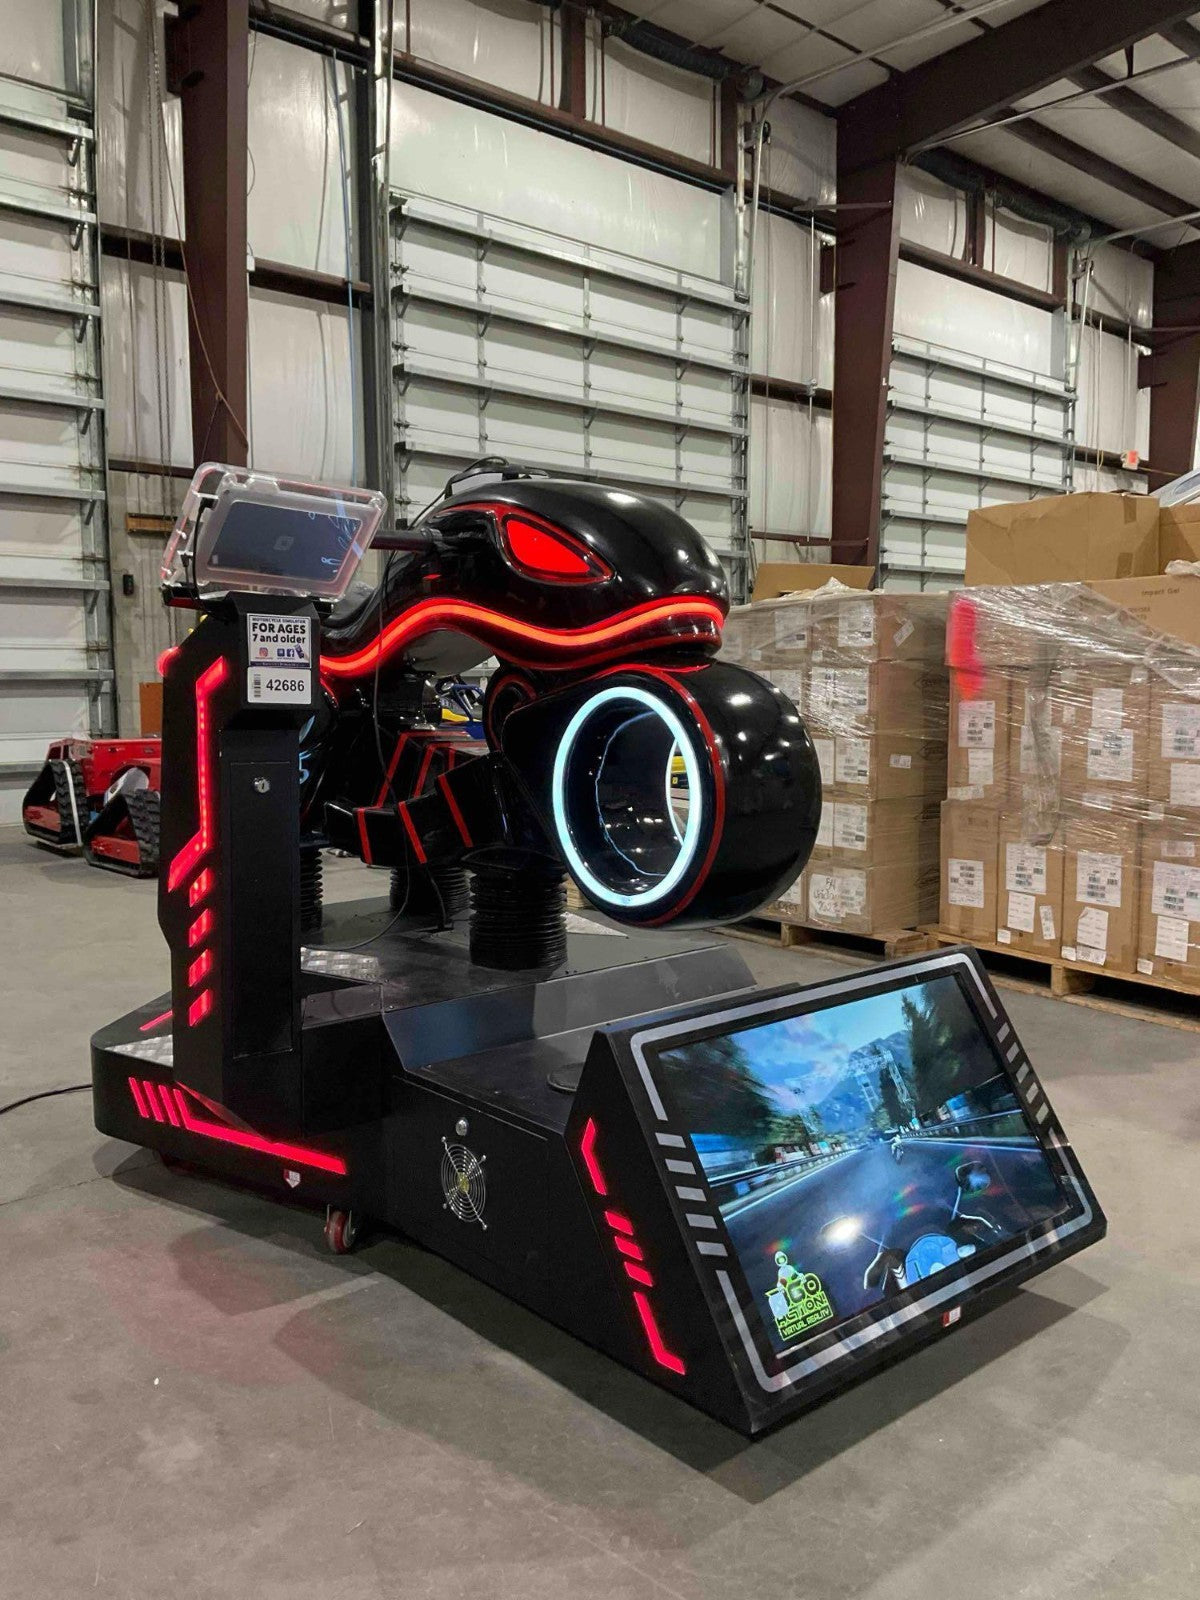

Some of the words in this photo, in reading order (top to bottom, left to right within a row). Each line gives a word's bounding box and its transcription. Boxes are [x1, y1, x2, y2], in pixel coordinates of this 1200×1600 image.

[252, 623, 275, 633] FOR
[277, 623, 306, 634] AGES
[252, 634, 258, 642] 7
[259, 634, 279, 643] and
[280, 634, 306, 644] older
[266, 679, 305, 692] 42686
[782, 1319, 808, 1336] VIRTUAL
[807, 1308, 830, 1326] REALITY
